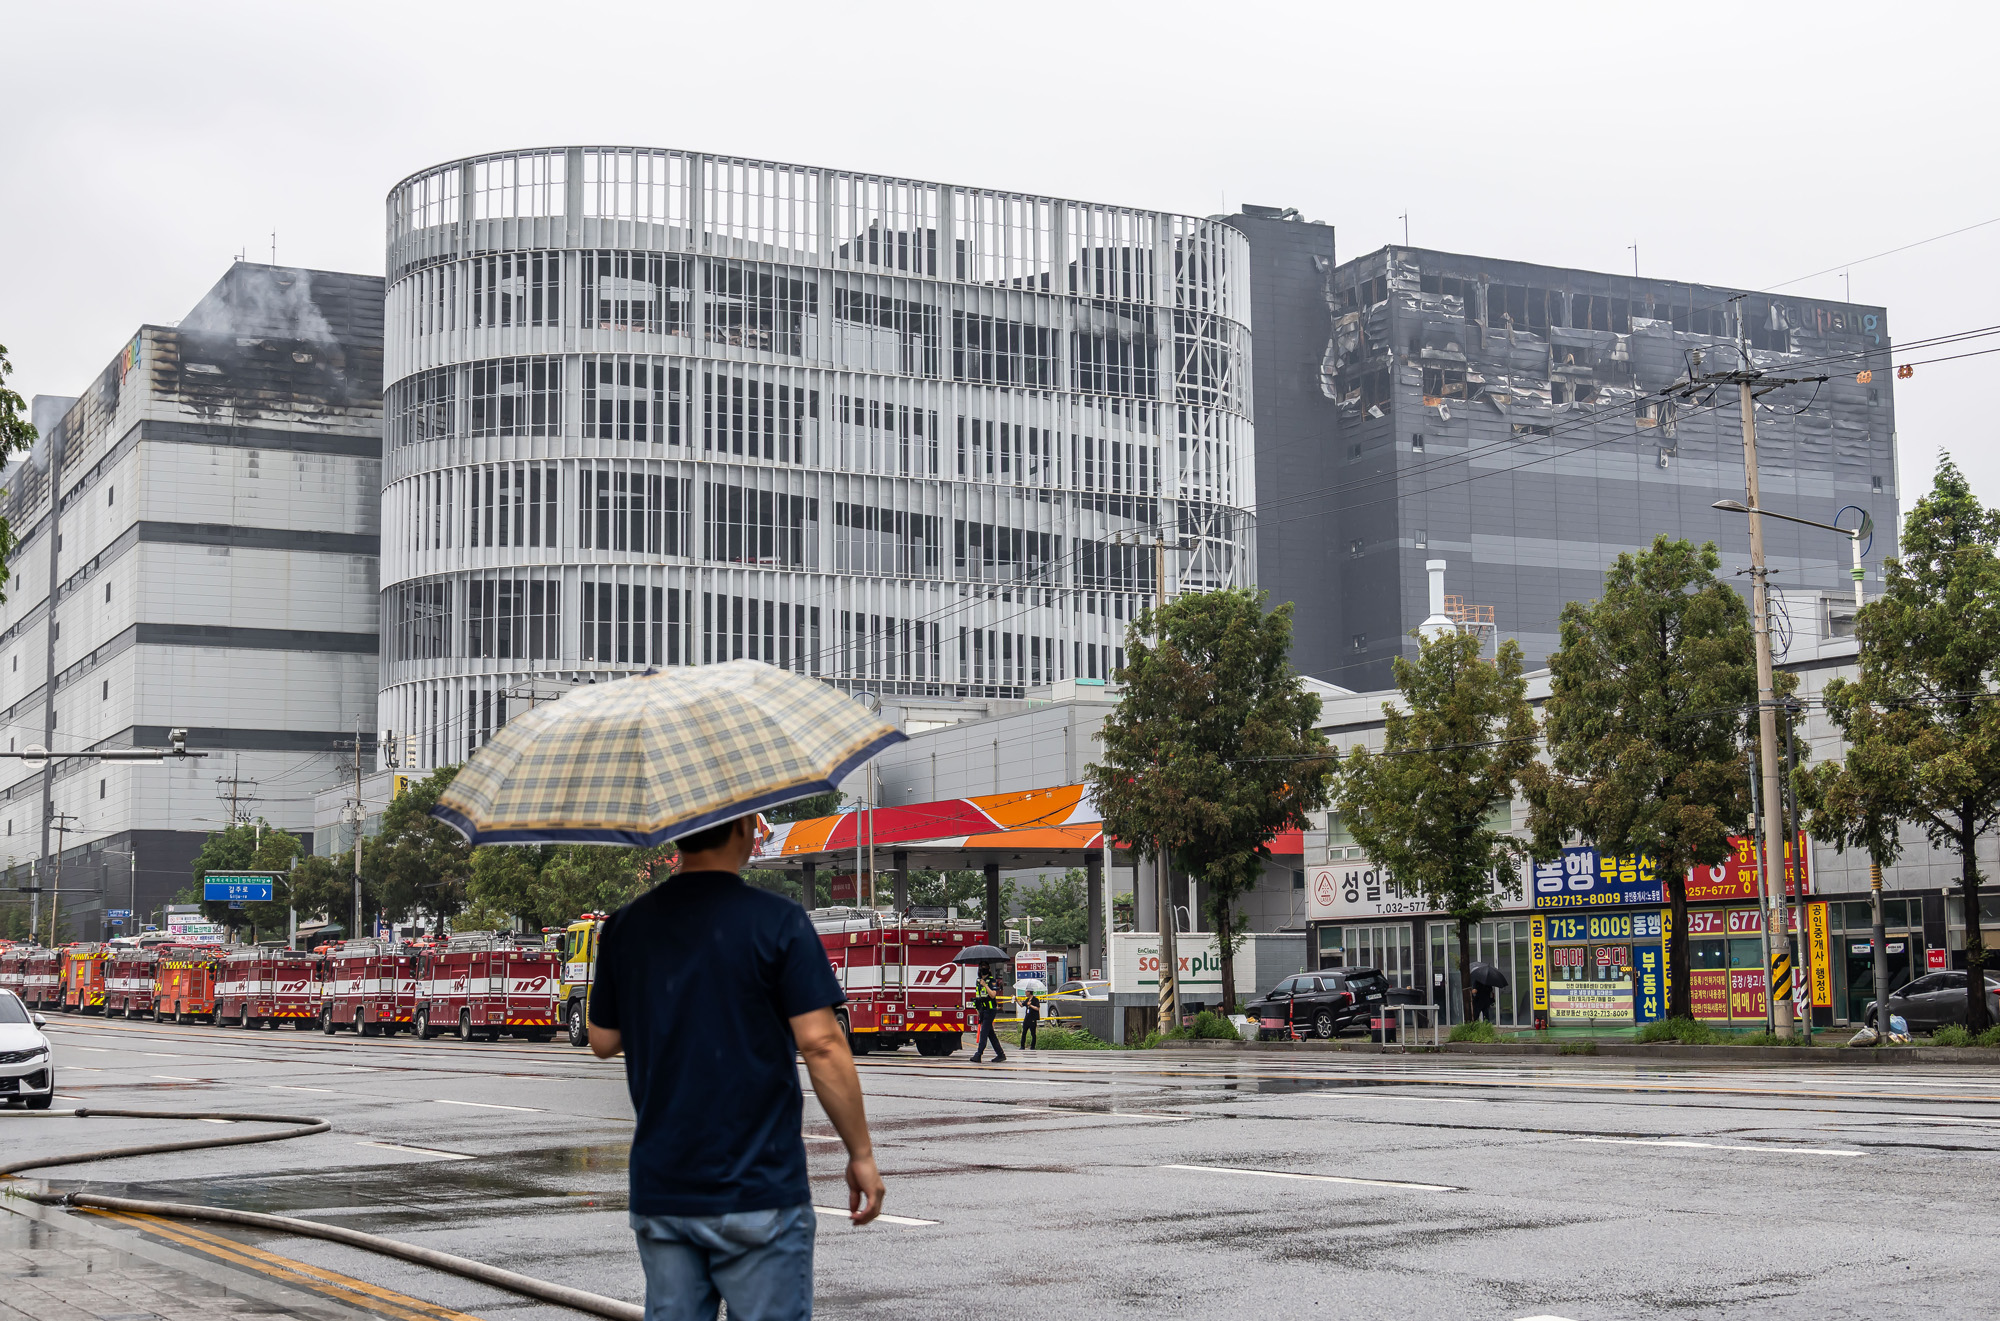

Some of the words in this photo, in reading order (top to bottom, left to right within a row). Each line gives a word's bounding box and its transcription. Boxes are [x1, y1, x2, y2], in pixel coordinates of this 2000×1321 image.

[1766, 298, 1879, 345] oupang
[1535, 852, 1595, 892] 동행
[1600, 853, 1657, 884] 부동산
[229, 886, 248, 895] 길주로
[1537, 893, 1621, 907] 032)713-8009
[1550, 918, 1585, 938] 713-
[1591, 917, 1630, 938] 8009
[1633, 914, 1661, 936] 동행
[1728, 911, 1769, 930] 677
[1532, 920, 1546, 1006] 공장전문
[1553, 948, 1585, 967] 매매
[1596, 947, 1628, 967] 임대
[913, 961, 958, 985] 119
[279, 979, 309, 993] 119
[453, 974, 467, 993] 119
[513, 976, 548, 993] 119
[1642, 952, 1658, 1018] 부동산
